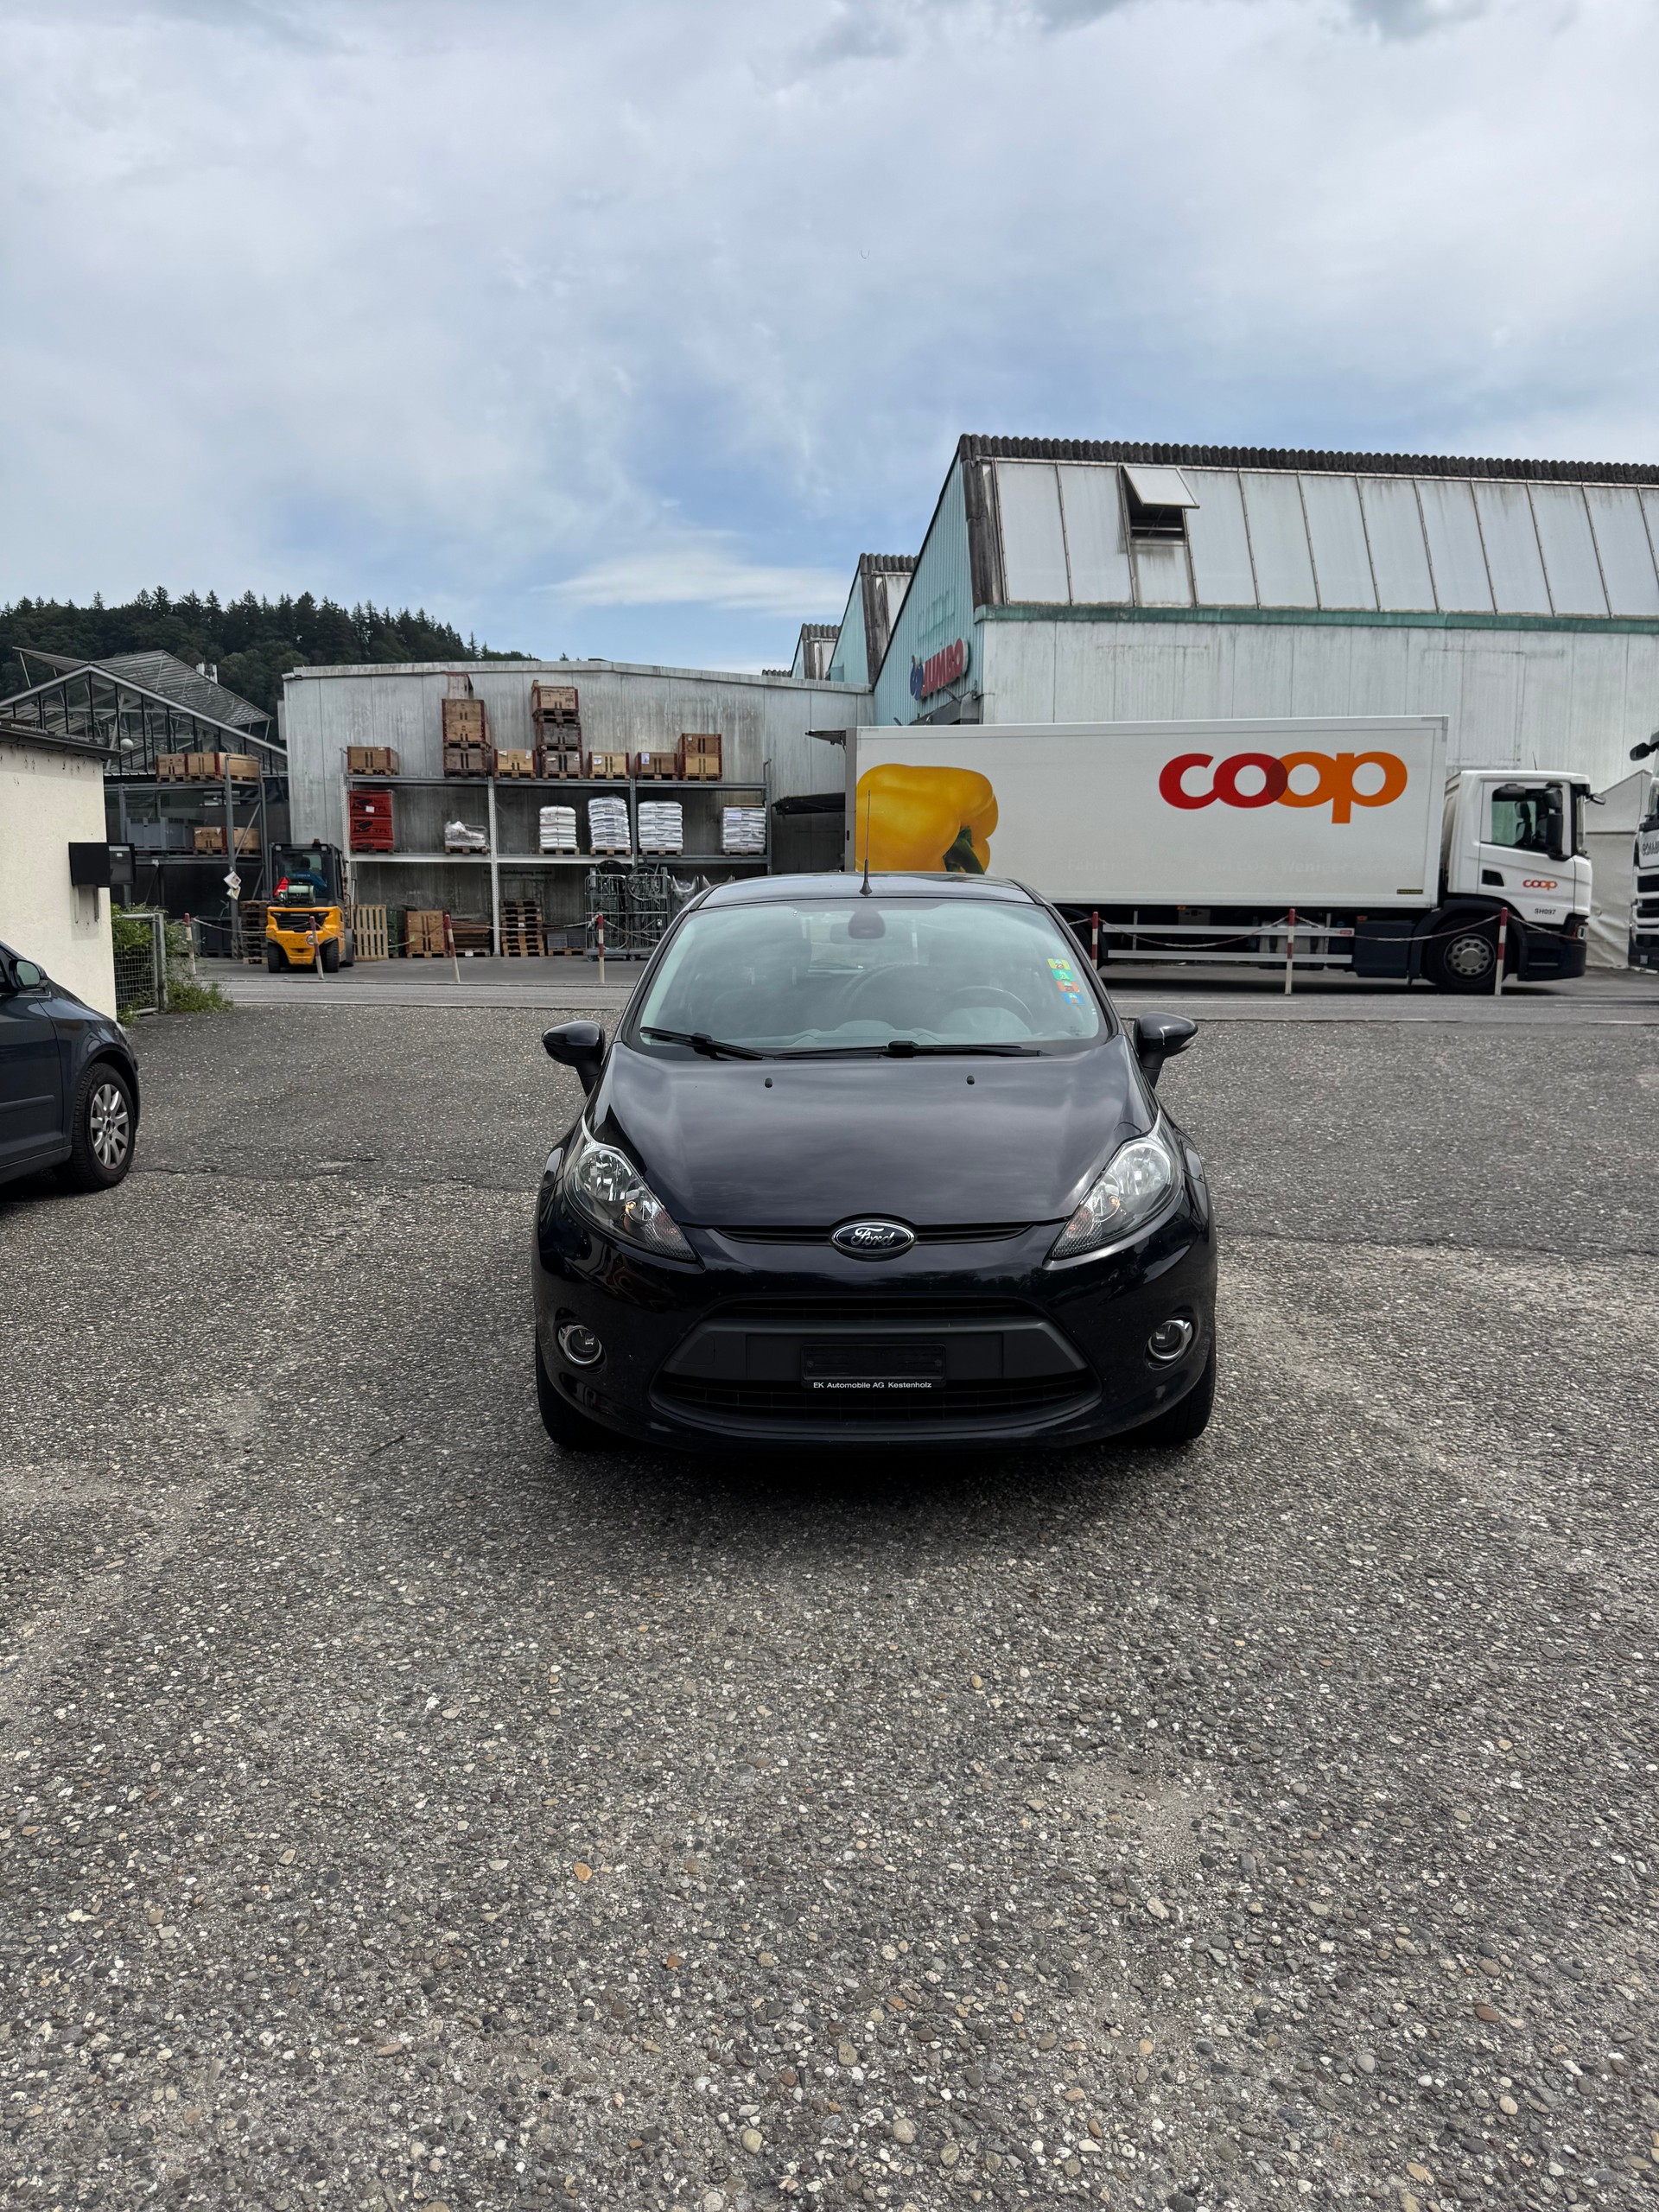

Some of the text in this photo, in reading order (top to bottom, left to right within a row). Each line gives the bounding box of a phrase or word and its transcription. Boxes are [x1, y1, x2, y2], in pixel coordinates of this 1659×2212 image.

[920, 638, 966, 698] JUMBO
[1159, 751, 1408, 823] coop
[1522, 879, 1558, 891] coop
[850, 1227, 895, 1246] Ford
